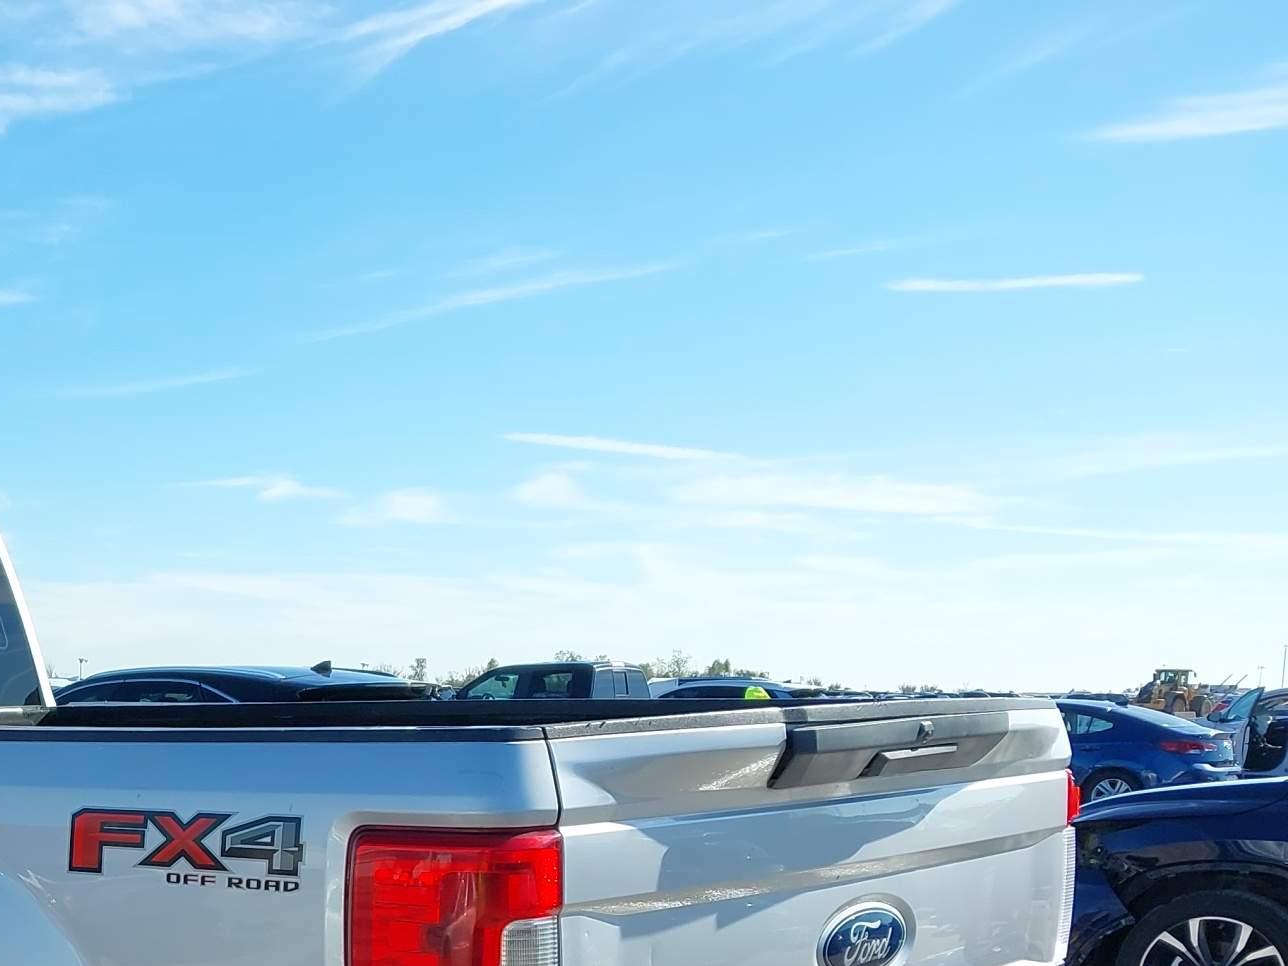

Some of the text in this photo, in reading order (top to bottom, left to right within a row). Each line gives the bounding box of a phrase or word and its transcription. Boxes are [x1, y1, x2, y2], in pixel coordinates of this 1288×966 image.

[68, 807, 304, 877] FX4
[166, 872, 300, 893] OFF ROAD
